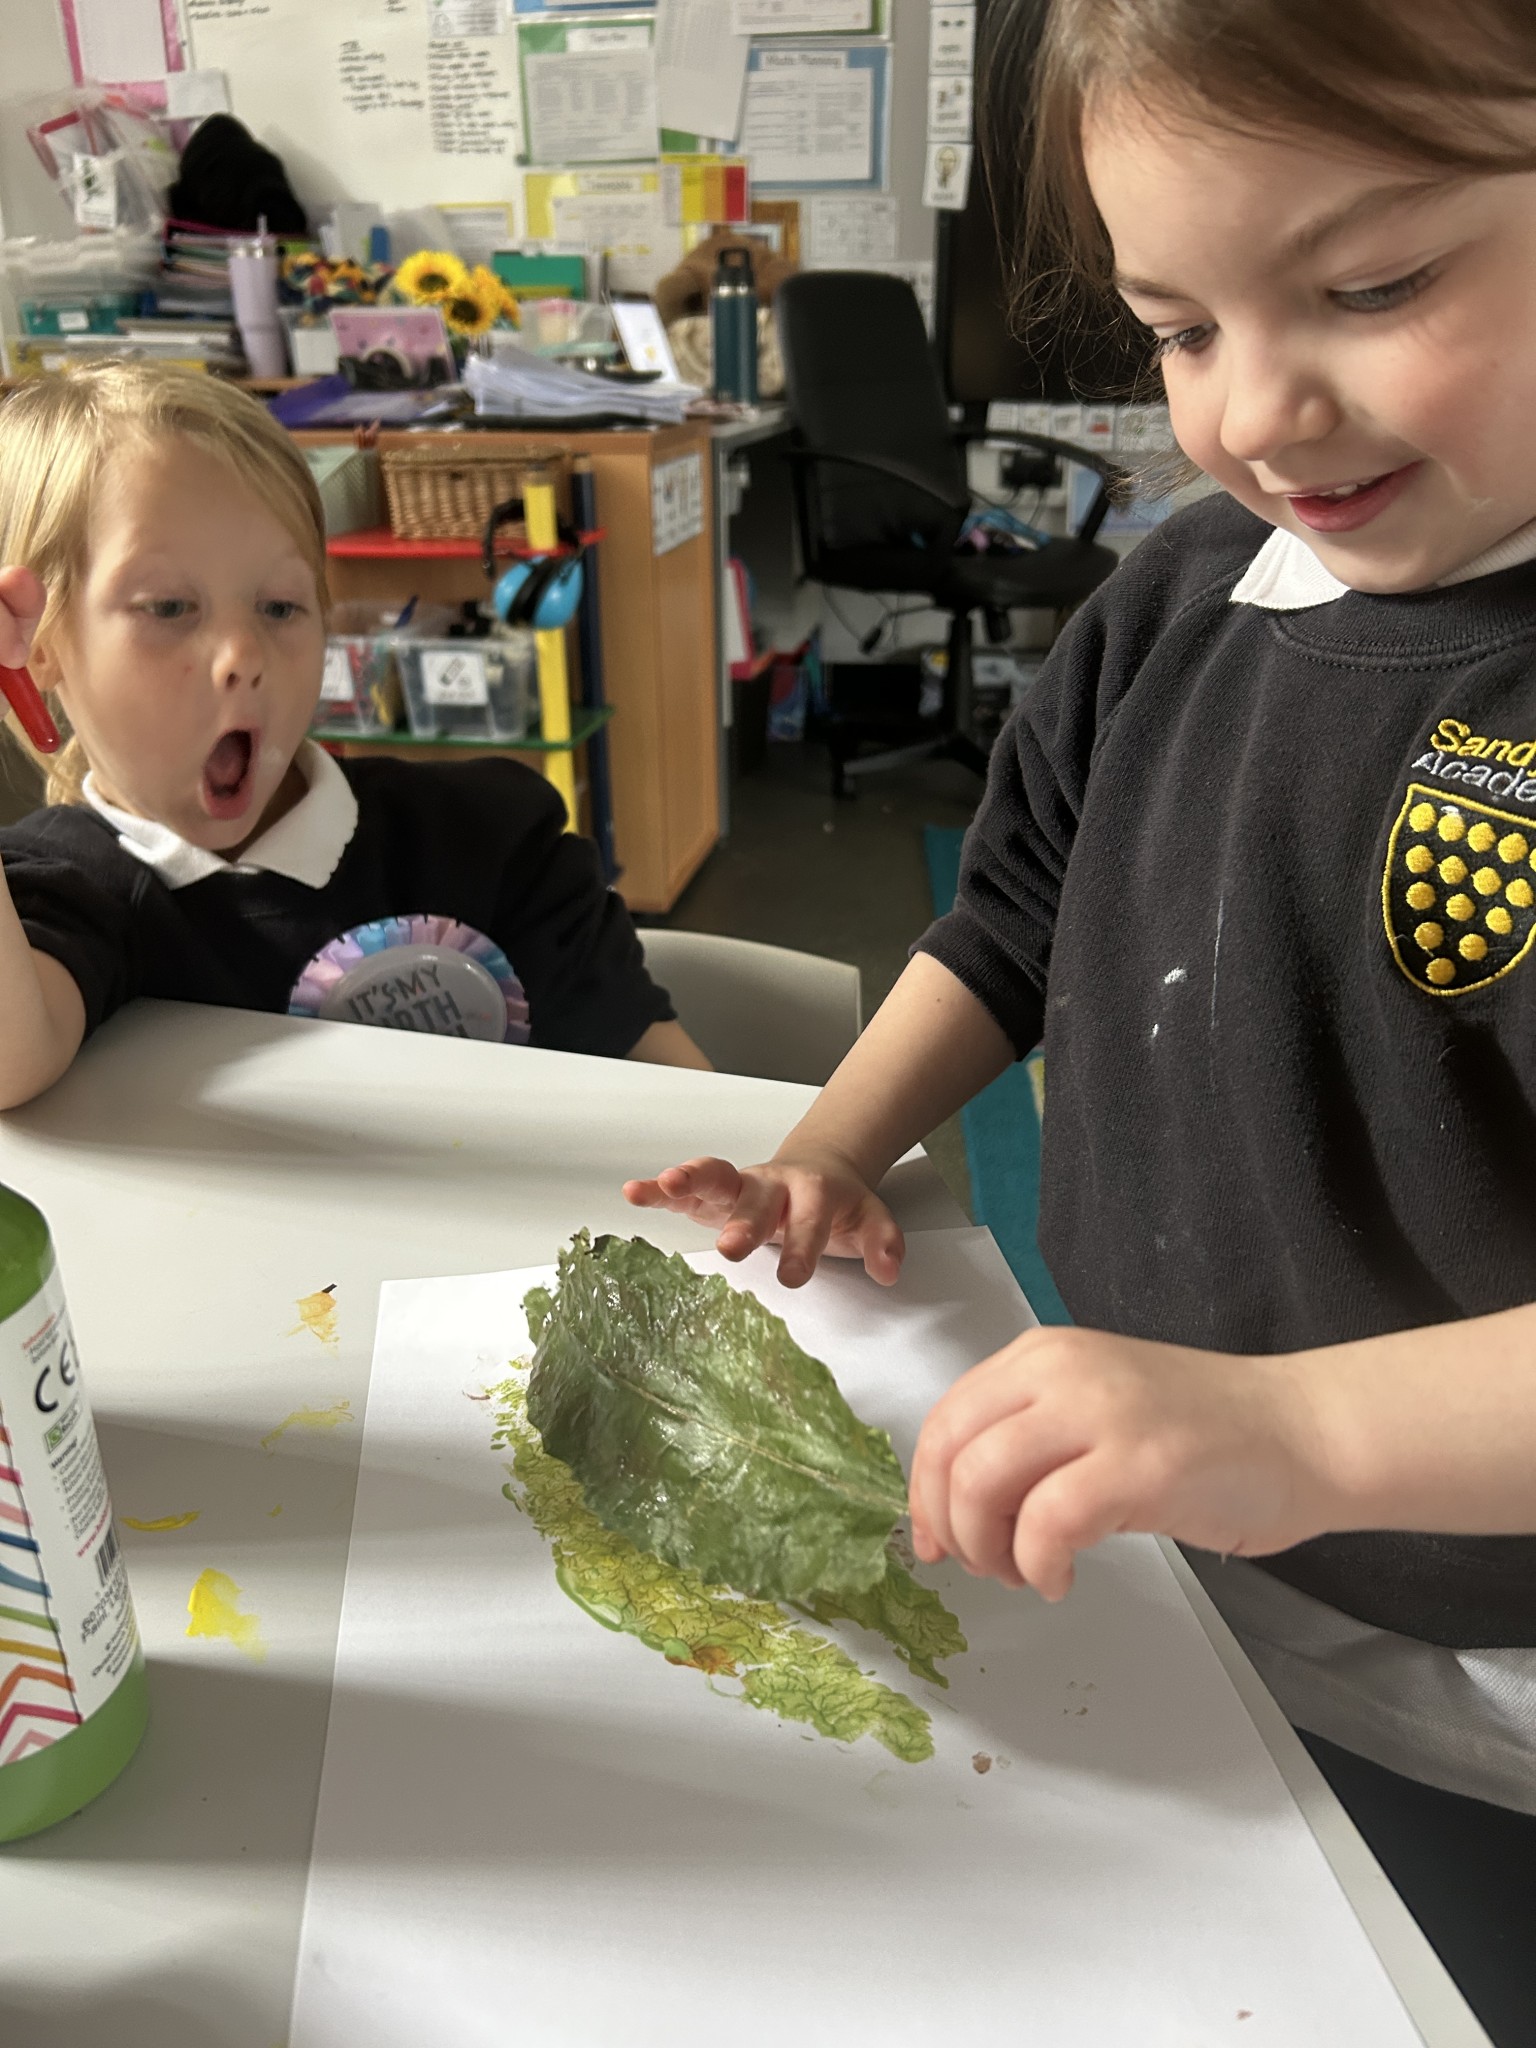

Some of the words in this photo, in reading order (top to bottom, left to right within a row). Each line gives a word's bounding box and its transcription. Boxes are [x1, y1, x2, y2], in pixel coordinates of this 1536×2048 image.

[1430, 718, 1536, 777] Sand
[348, 983, 398, 1020] IT'S
[394, 964, 440, 1000] MY
